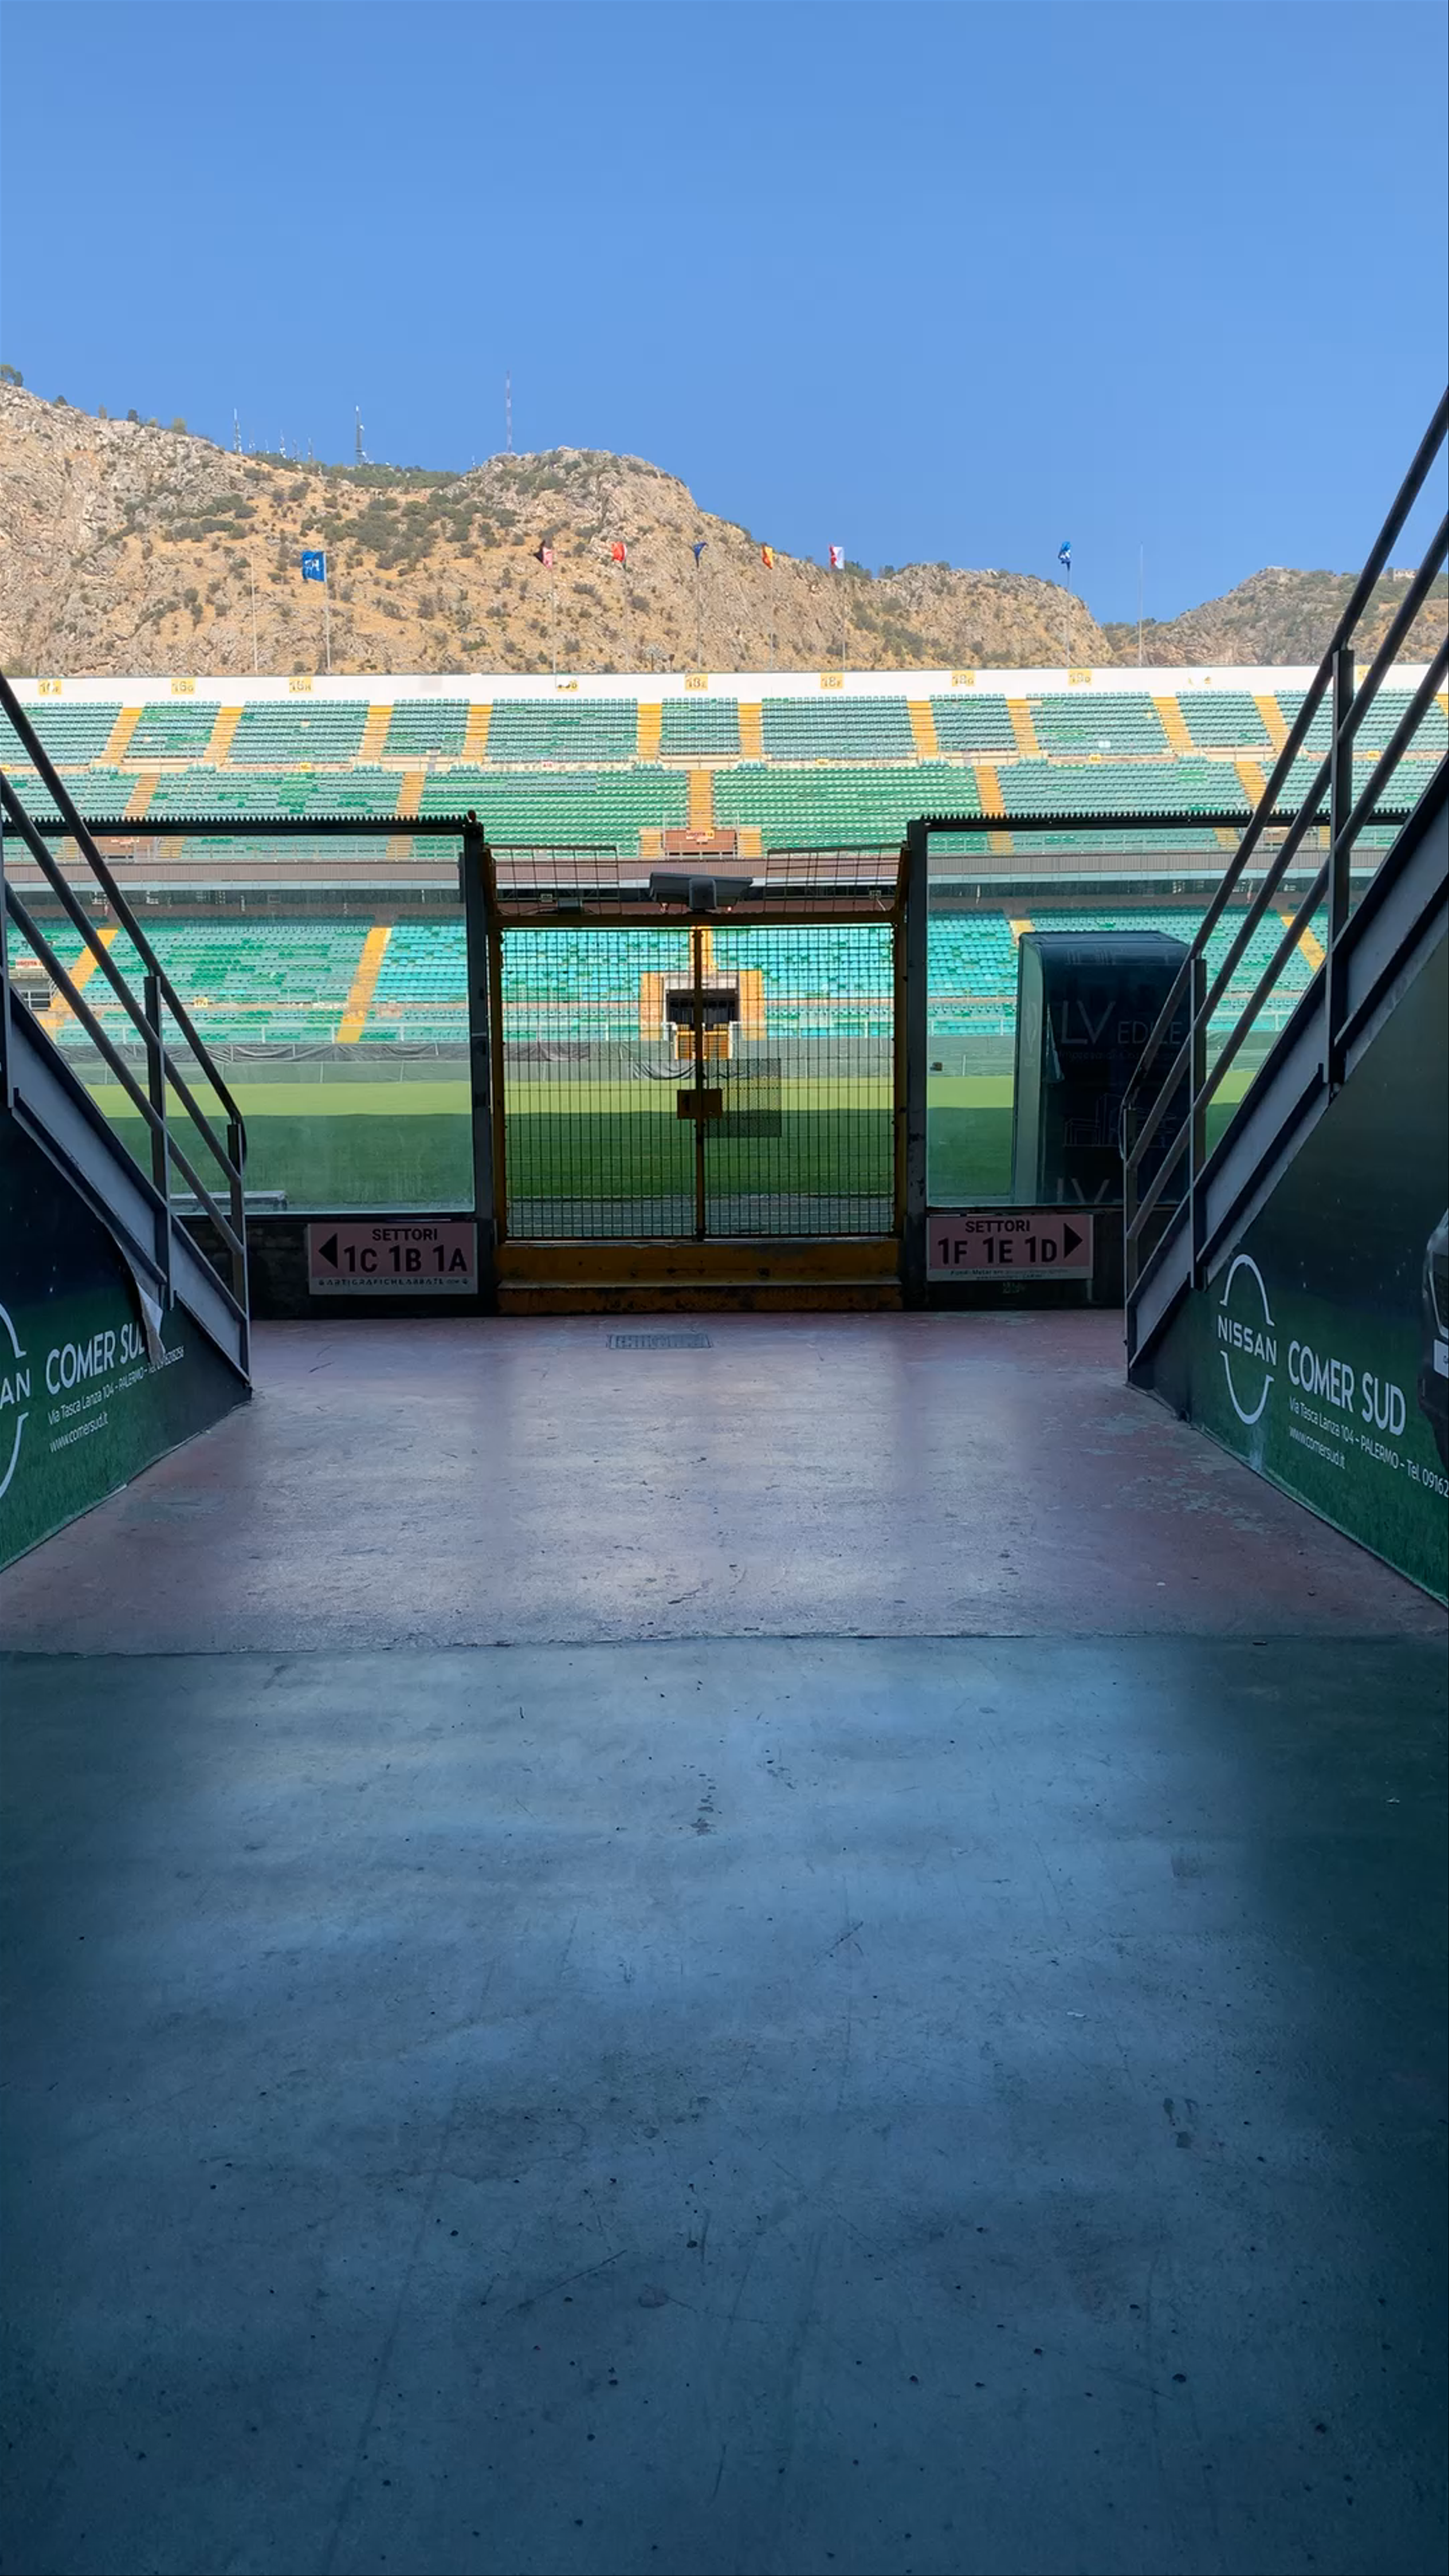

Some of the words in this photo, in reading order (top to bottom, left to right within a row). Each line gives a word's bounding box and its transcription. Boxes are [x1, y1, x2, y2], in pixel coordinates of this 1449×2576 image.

[1061, 1000, 1116, 1045] LV
[372, 1229, 437, 1241] SETTORI
[965, 1220, 1030, 1233] SETTORI
[343, 1245, 377, 1273] 1C
[389, 1245, 421, 1272] 1B
[432, 1244, 468, 1272] 1A
[938, 1238, 968, 1264] 1F
[983, 1236, 1013, 1263] 1E
[1025, 1236, 1057, 1263] 1D
[1218, 1315, 1276, 1366] NISSAN
[46, 1330, 115, 1395] COMER
[48, 1409, 60, 1425] Via
[61, 1404, 81, 1418] Tasca
[81, 1390, 102, 1409] Lanza
[103, 1383, 114, 1399] 104
[1288, 1340, 1354, 1413] COMER
[1361, 1371, 1406, 1436] SUD
[49, 1411, 109, 1453] www.comersud.it
[1289, 1396, 1299, 1414] Via
[1300, 1402, 1318, 1425] Tasca
[1319, 1412, 1340, 1437] Lanza
[1341, 1425, 1354, 1445] 104
[1361, 1435, 1399, 1469] PALERMO
[1289, 1425, 1346, 1469] www.comersud.it
